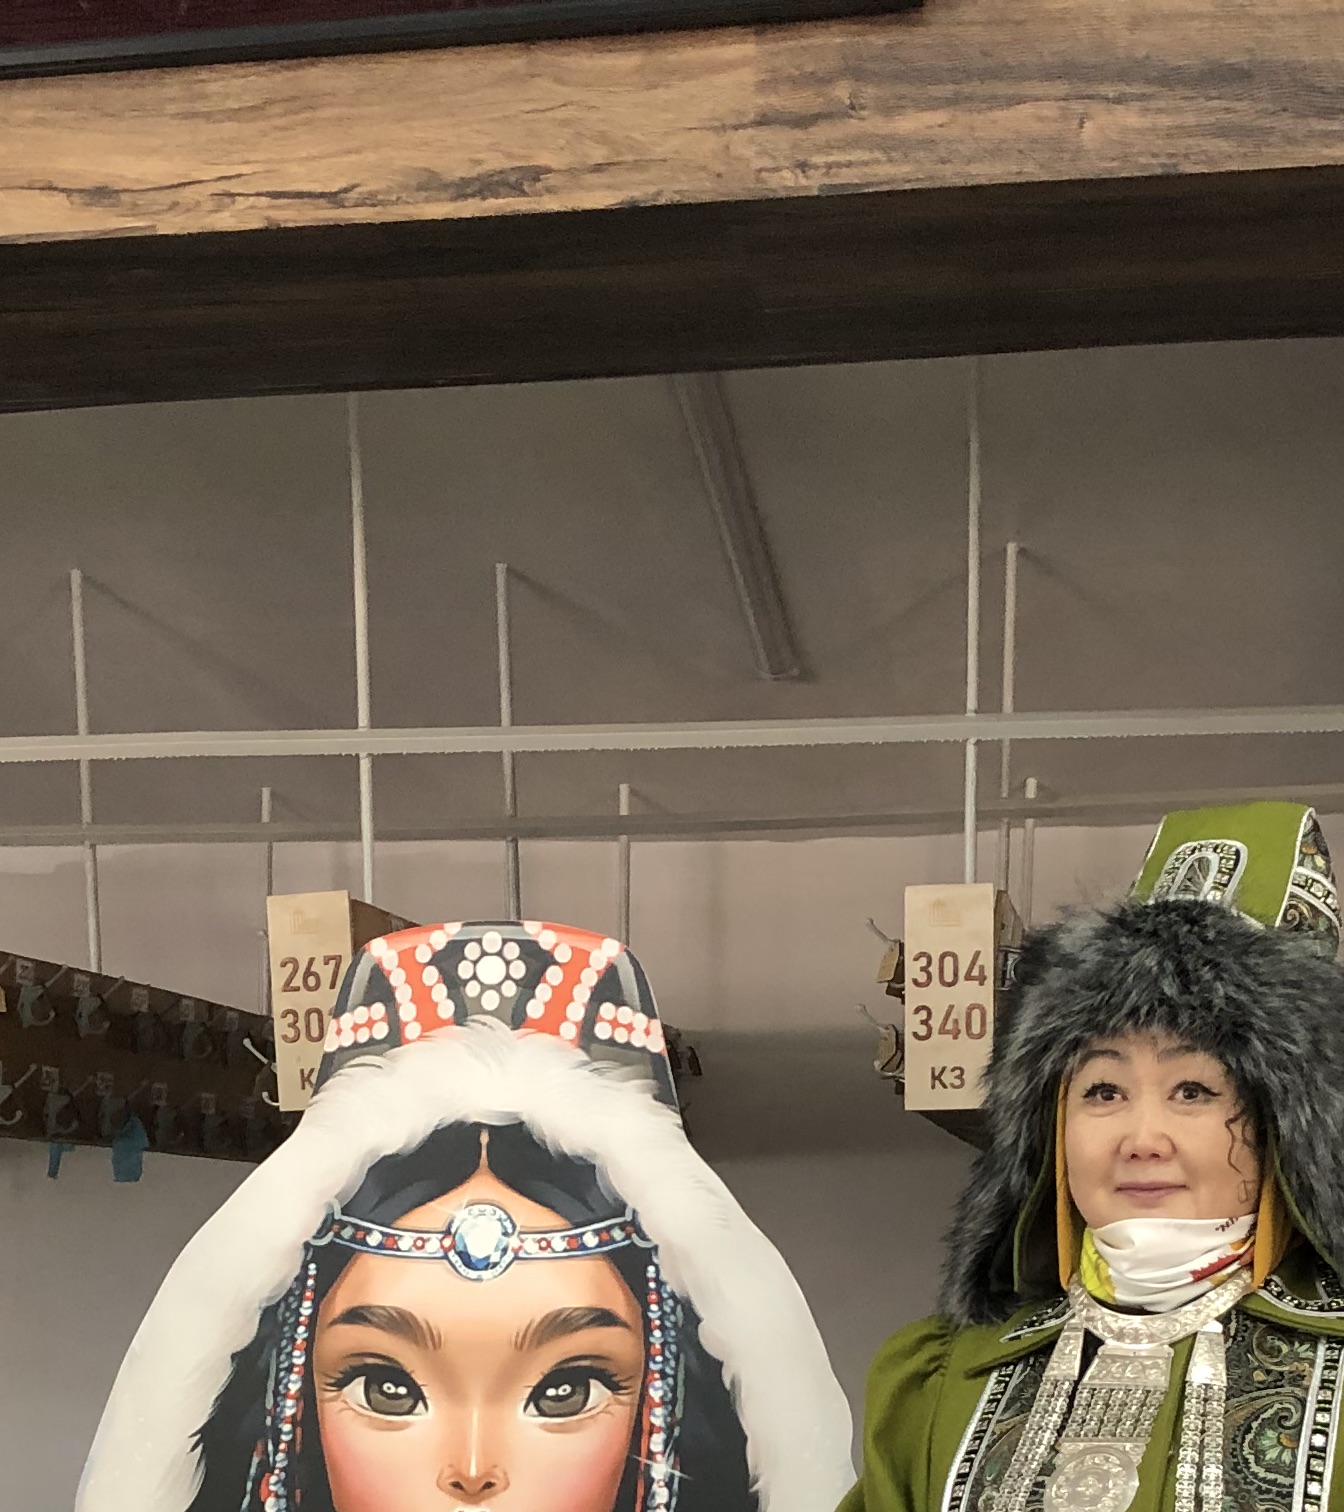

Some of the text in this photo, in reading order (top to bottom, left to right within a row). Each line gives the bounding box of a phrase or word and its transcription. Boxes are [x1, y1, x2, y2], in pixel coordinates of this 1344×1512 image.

[280, 954, 342, 992] 267
[912, 950, 987, 988] 304
[280, 1007, 334, 1043] 30
[912, 1003, 987, 1041] 340
